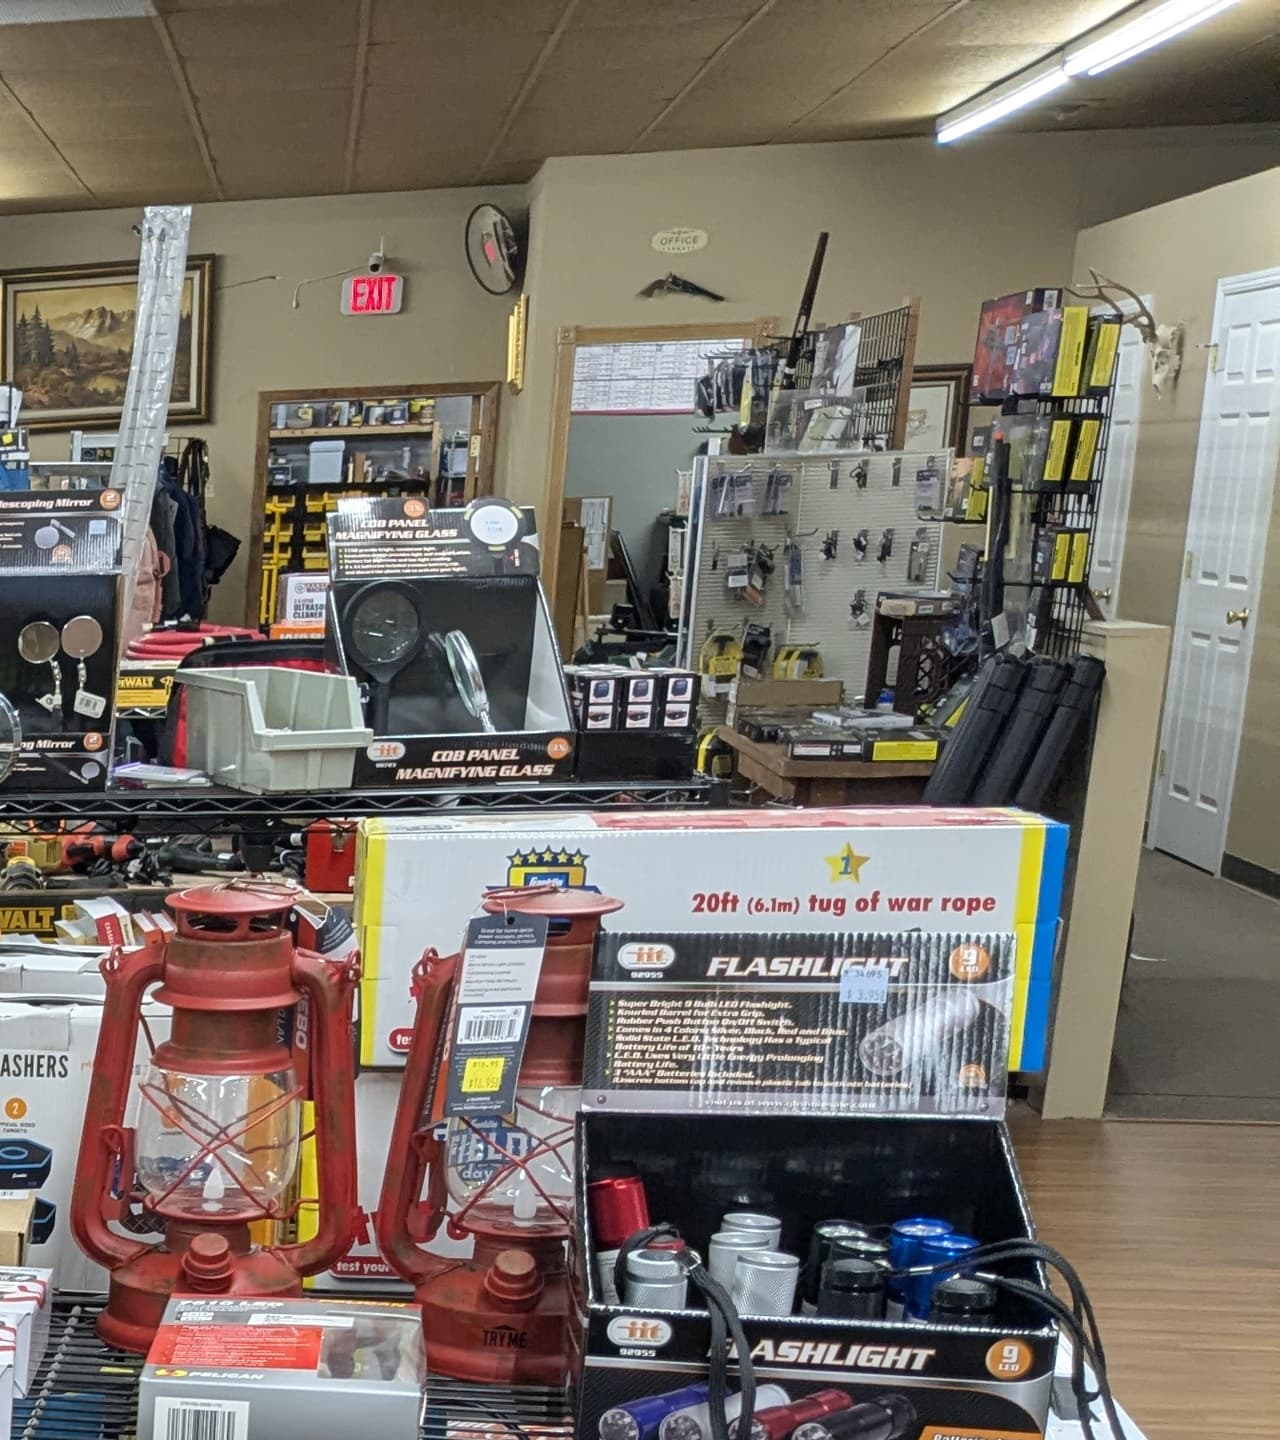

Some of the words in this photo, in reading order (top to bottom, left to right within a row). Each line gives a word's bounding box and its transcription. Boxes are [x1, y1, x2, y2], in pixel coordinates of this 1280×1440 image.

[351, 276, 396, 312] EXIT
[55, 498, 94, 508] Mirror
[335, 530, 414, 540] MAGNIFYING
[416, 529, 459, 539] GLASS
[432, 750, 466, 763] COB
[468, 748, 520, 762] PANEL
[395, 767, 494, 781] MAGNIFYING
[495, 764, 554, 777] GLASS
[691, 892, 740, 914] 20ft
[808, 892, 846, 917] tug
[855, 892, 882, 913] of
[887, 895, 933, 913] war
[940, 895, 997, 917] rope
